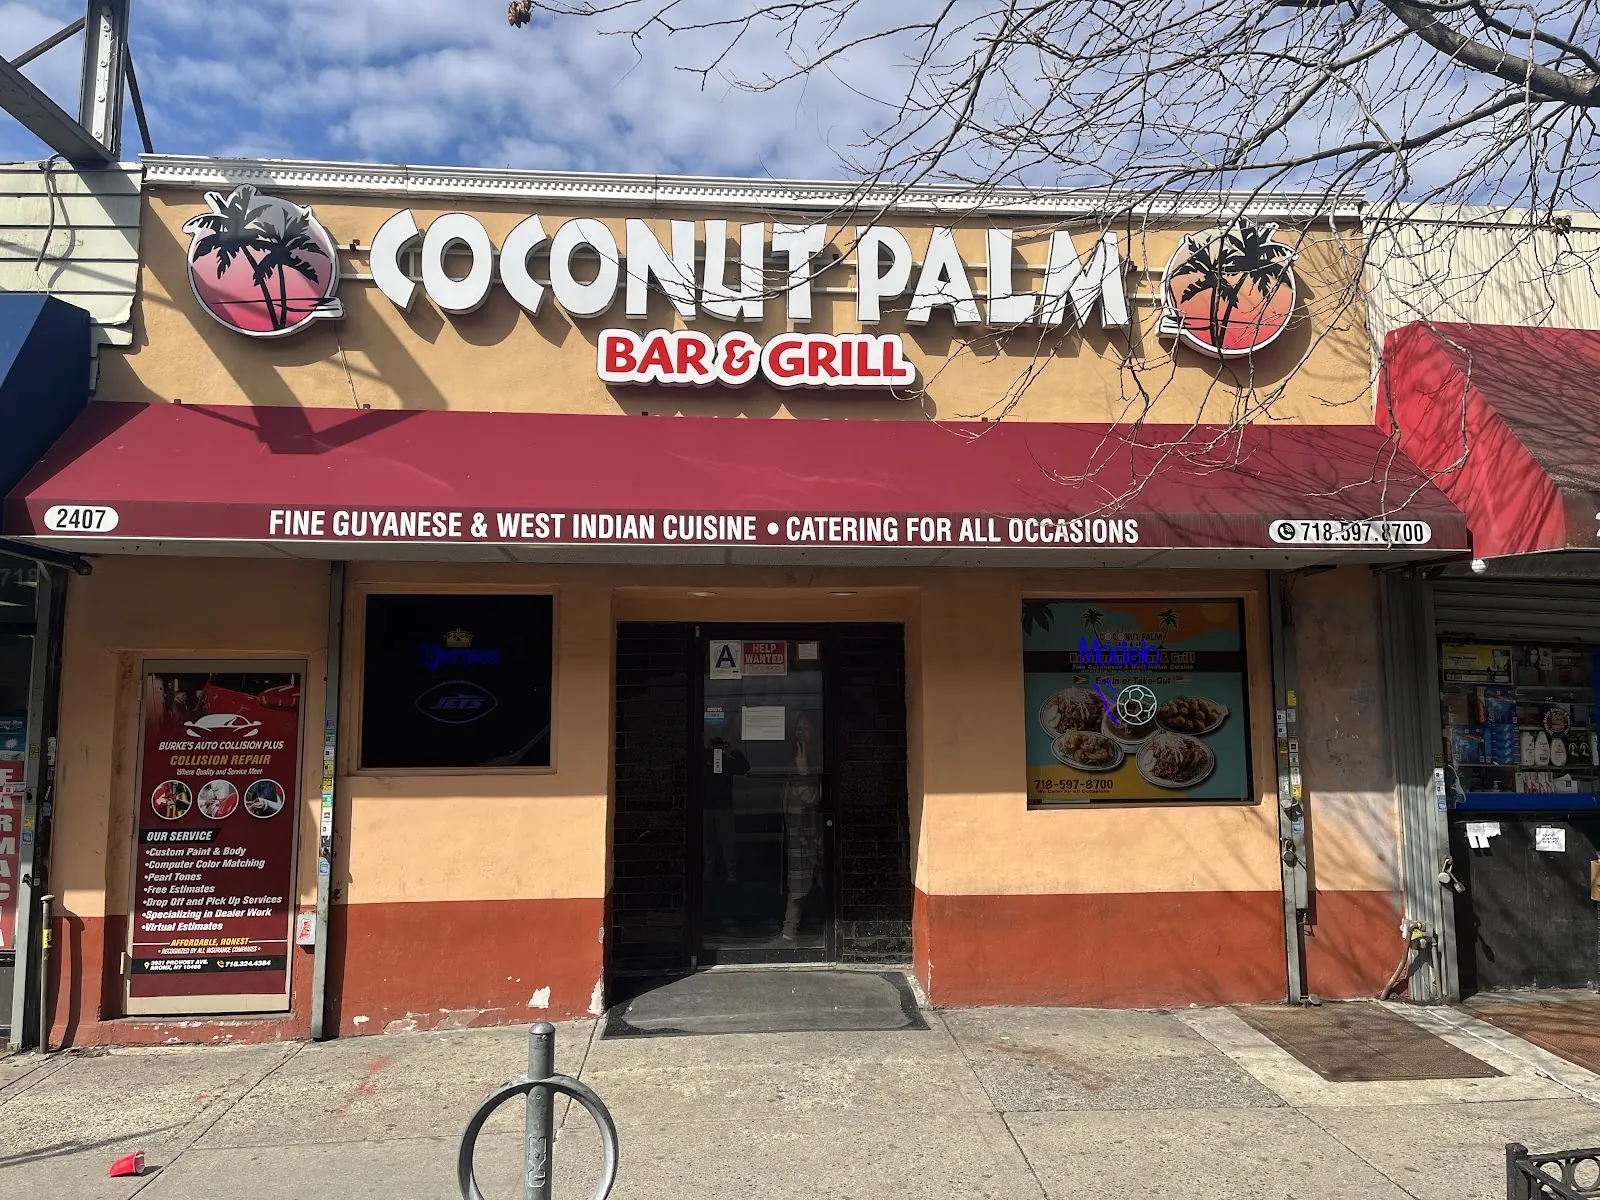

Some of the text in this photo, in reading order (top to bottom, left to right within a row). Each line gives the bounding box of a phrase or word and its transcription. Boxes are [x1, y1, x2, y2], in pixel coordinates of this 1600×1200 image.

[369, 207, 1131, 329] COCONUT PALM
[604, 336, 906, 380] BAR & GRILL
[55, 508, 107, 530] 2407
[269, 510, 1139, 543] FINE GUYANESE & WEST INDIAN CUISINE CATERING FOR ALL OCCASIONS
[1300, 522, 1424, 542] 718.597.8700
[1099, 632, 1163, 641] COCONUT PALM
[752, 643, 777, 653] HELP
[1079, 637, 1161, 667] Modelo
[715, 644, 737, 668] A
[744, 653, 785, 664] WANTED
[1170, 651, 1196, 664] Grill
[1133, 676, 1172, 685] Take-Out
[429, 692, 486, 710] JETS
[158, 740, 285, 751] BURKE'S AUTO COLLISION PLUS
[169, 754, 272, 767] COLLISION REPAIR
[176, 768, 195, 776] Where
[195, 768, 216, 777] Quality
[215, 768, 227, 776] and
[226, 768, 248, 776] Service
[1034, 779, 1114, 790] 718-597-8700
[146, 831, 213, 842] OUR SERVICE
[149, 847, 247, 857] Custom Paint & Body
[148, 858, 266, 870] Computer Color Matching
[147, 873, 202, 881] Pearl Tones
[146, 884, 216, 894] Free Estimates
[145, 895, 283, 908] Drop Off and Pick Up Services
[145, 908, 272, 921] Specializing in Dealer Work
[145, 921, 224, 931] Virtual Estimates
[170, 937, 250, 947] AFFORDABLE, HONEST
